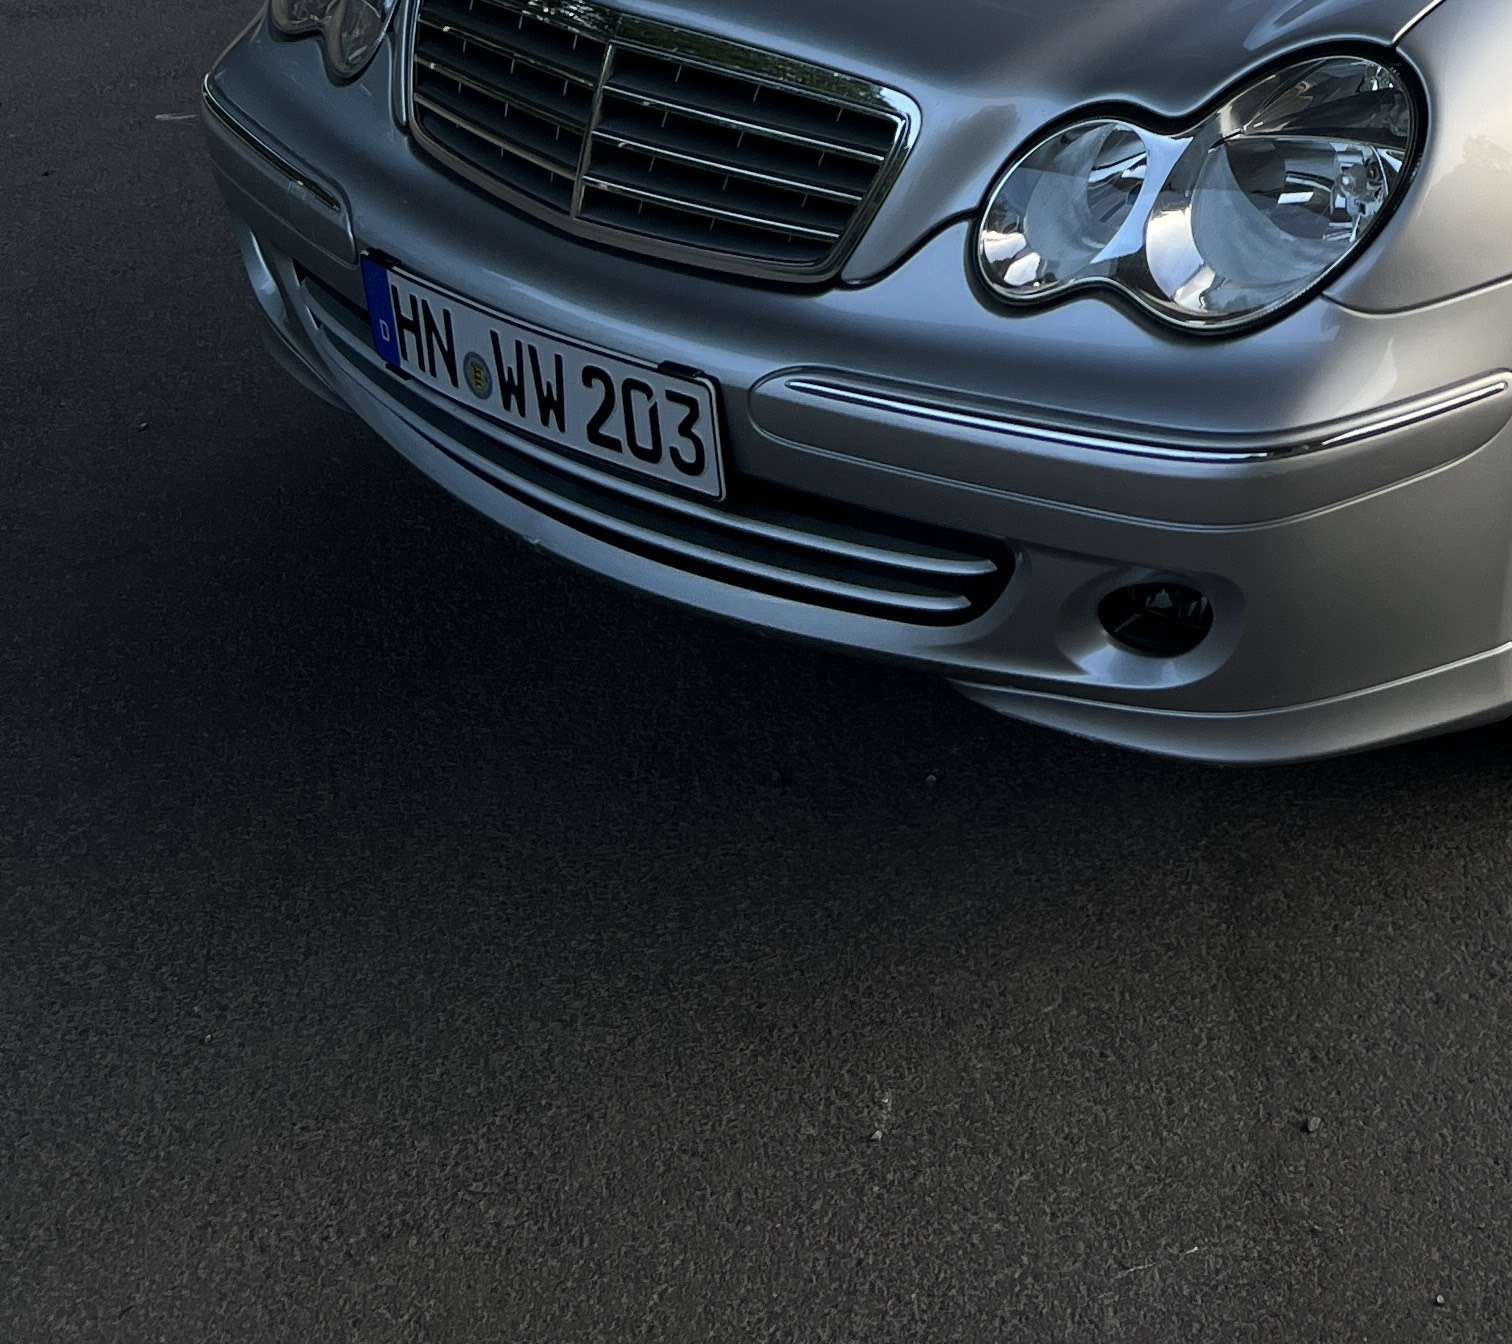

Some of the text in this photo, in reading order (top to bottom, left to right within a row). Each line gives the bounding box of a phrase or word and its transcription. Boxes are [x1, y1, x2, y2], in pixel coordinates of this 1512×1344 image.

[379, 318, 390, 342] D
[391, 284, 706, 477] HN WW 203
